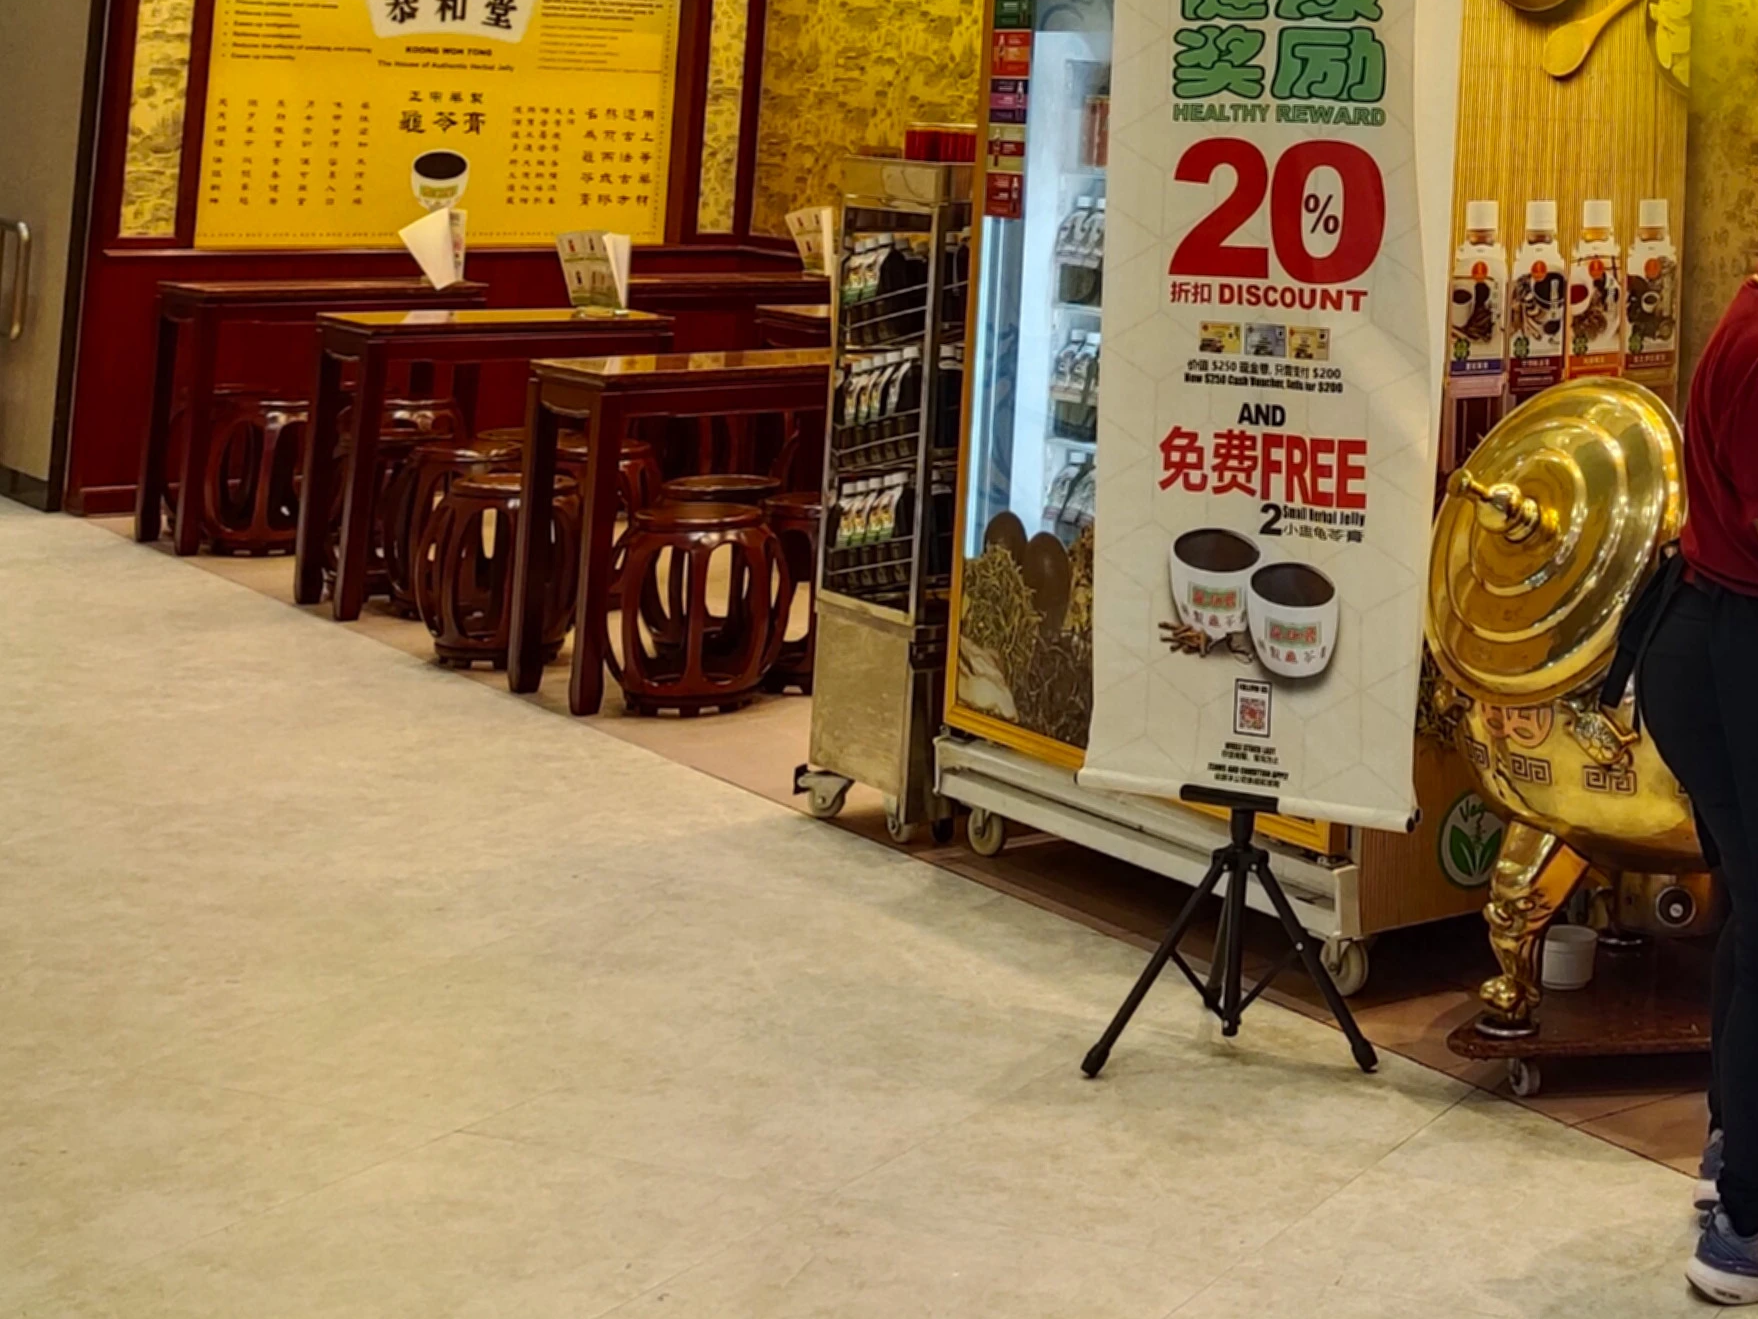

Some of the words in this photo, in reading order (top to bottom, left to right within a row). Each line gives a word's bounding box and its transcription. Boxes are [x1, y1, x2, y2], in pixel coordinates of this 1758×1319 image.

[405, 46, 440, 55] KOONG
[442, 47, 464, 56] WOH
[467, 48, 492, 57] TONG
[432, 62, 467, 70] Authentic
[470, 63, 495, 71] Herbal
[498, 64, 514, 72] Jelly
[1172, 24, 1387, 103] 奖励
[1173, 103, 1270, 123] HEALTHY
[1276, 105, 1387, 126] REWARD
[1170, 281, 1211, 304] 折扣
[1219, 283, 1368, 312] DISCOUNT
[1212, 360, 1237, 372] $250
[1313, 367, 1342, 379] $200
[1318, 382, 1344, 394] $200
[1237, 402, 1286, 426] AND
[1158, 426, 1259, 497] 免费
[1261, 433, 1367, 509] FREE
[1259, 503, 1283, 536] 2
[1283, 505, 1308, 521] Small
[1309, 508, 1338, 525] Herbal
[1340, 511, 1366, 527] Jelly
